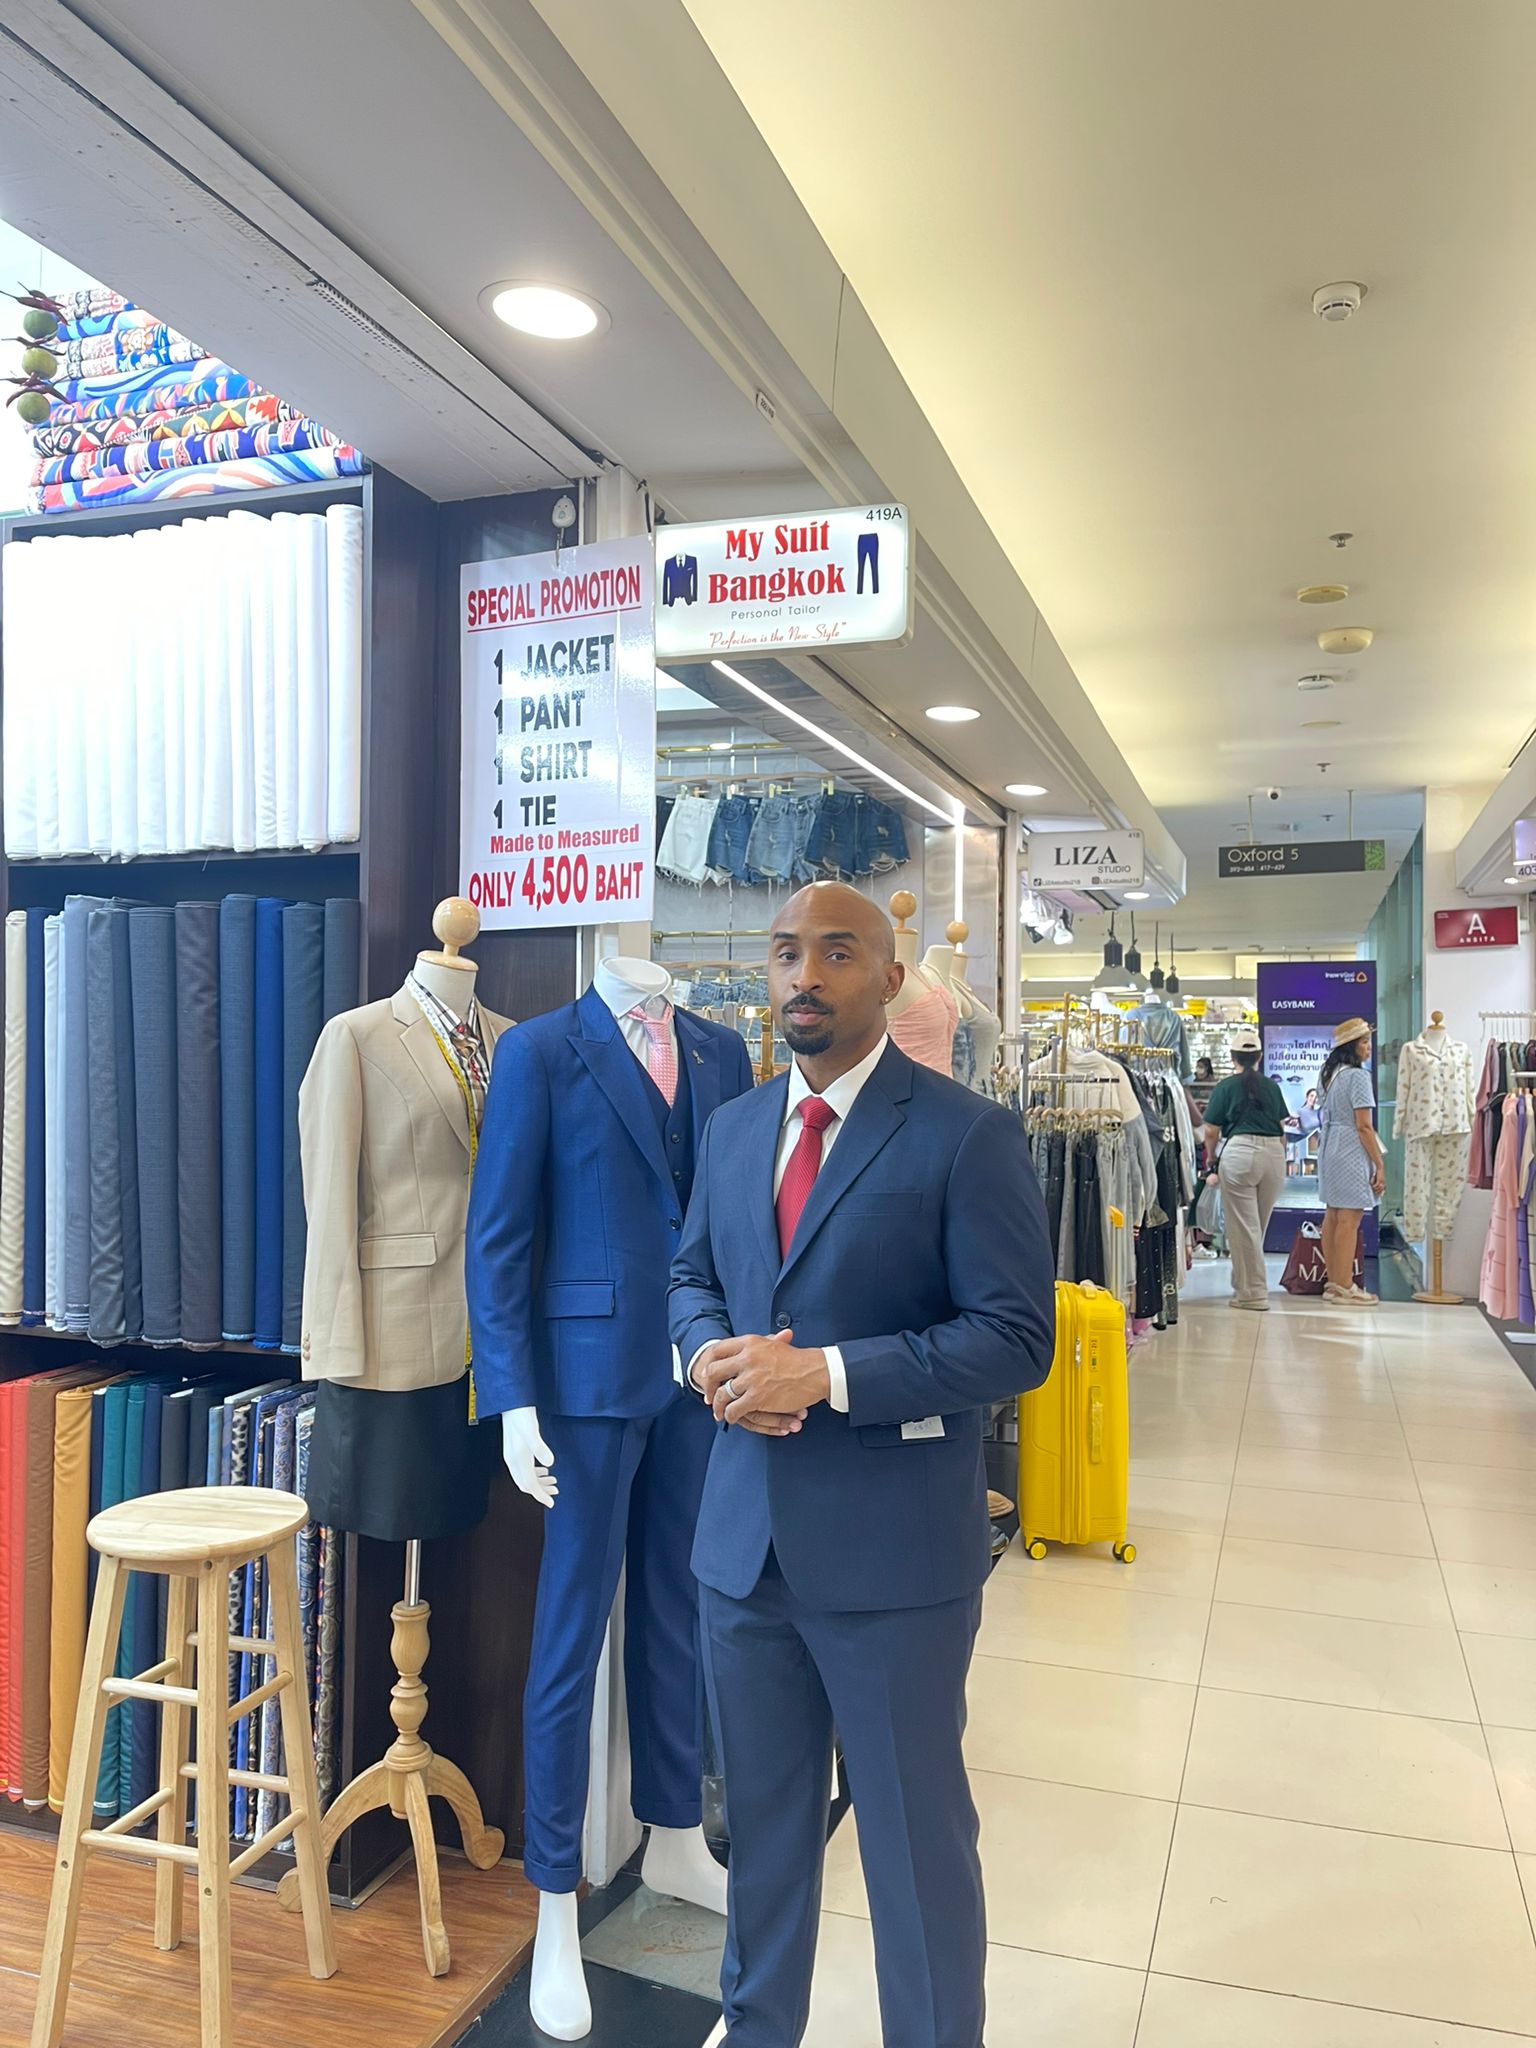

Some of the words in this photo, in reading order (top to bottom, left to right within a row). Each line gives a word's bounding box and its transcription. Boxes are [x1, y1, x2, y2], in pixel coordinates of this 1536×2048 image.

[866, 507, 902, 521] 419A
[725, 529, 764, 561] My
[774, 521, 829, 555] Suit
[467, 583, 535, 627] SPECIAL
[541, 565, 640, 617] PROMOTION
[708, 563, 846, 603] Bangkok
[731, 608, 782, 620] Personal
[788, 605, 821, 616] Tailor
[760, 634, 767, 643] is
[770, 628, 783, 641] the
[493, 649, 503, 685] 1
[520, 634, 614, 678] JACKET
[493, 699, 503, 735] 1
[520, 689, 585, 732] PANT
[493, 749, 503, 785] 1
[520, 740, 592, 783] SHIRT
[493, 800, 503, 829] 1
[520, 795, 556, 827] TIE
[490, 834, 534, 853] Made
[538, 833, 553, 850] to
[558, 824, 639, 848] Measured
[1054, 845, 1118, 866] LIZA
[1097, 865, 1131, 874] STUDIO
[1228, 847, 1284, 863] Oxford
[1291, 848, 1299, 861] 5
[469, 871, 516, 908] ONLY
[522, 854, 588, 912] 4,500
[595, 862, 643, 901] BAHT
[1468, 913, 1486, 935] A
[1272, 1001, 1315, 1009] EASYBANK
